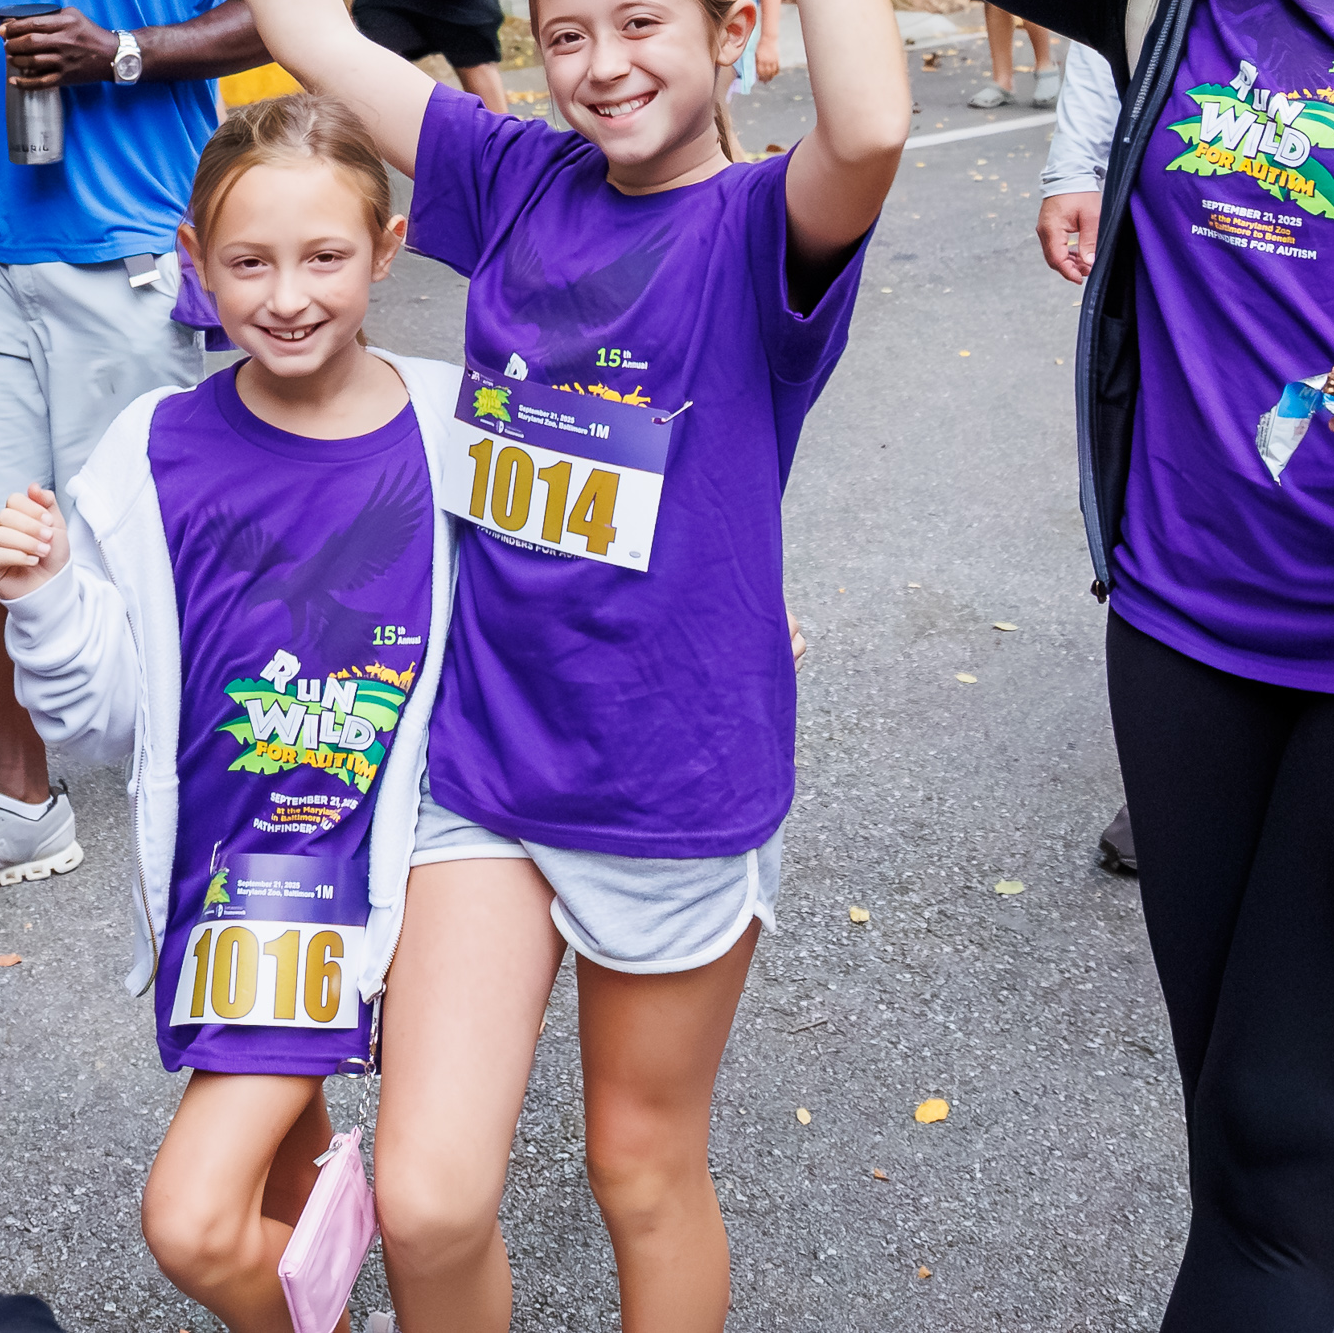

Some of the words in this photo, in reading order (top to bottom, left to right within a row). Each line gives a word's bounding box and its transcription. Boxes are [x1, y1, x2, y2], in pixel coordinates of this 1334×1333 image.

[1199, 101, 1310, 168] WILD
[1195, 141, 1235, 170] FOR
[1238, 157, 1316, 198] AUTISM
[1202, 199, 1261, 220] SEPTEMBER
[1262, 212, 1275, 224] 21,
[1278, 215, 1303, 227] 2025
[1218, 215, 1231, 223] the
[1233, 218, 1274, 232] Maryland
[1191, 225, 1248, 248] PATHFINDERS
[1250, 240, 1275, 253] FOR
[1276, 245, 1317, 260] AUTISM
[1253, 230, 1263, 239] to
[1265, 232, 1296, 244] Benefit
[595, 347, 621, 367] 15
[588, 423, 610, 440] 1M
[468, 438, 621, 556] 1014
[373, 626, 396, 645] 15
[245, 698, 376, 751] WILD
[255, 741, 297, 764] FOR
[270, 792, 328, 806] SEPTEMBER
[315, 884, 334, 900] 1M
[189, 926, 345, 1024] 1016
